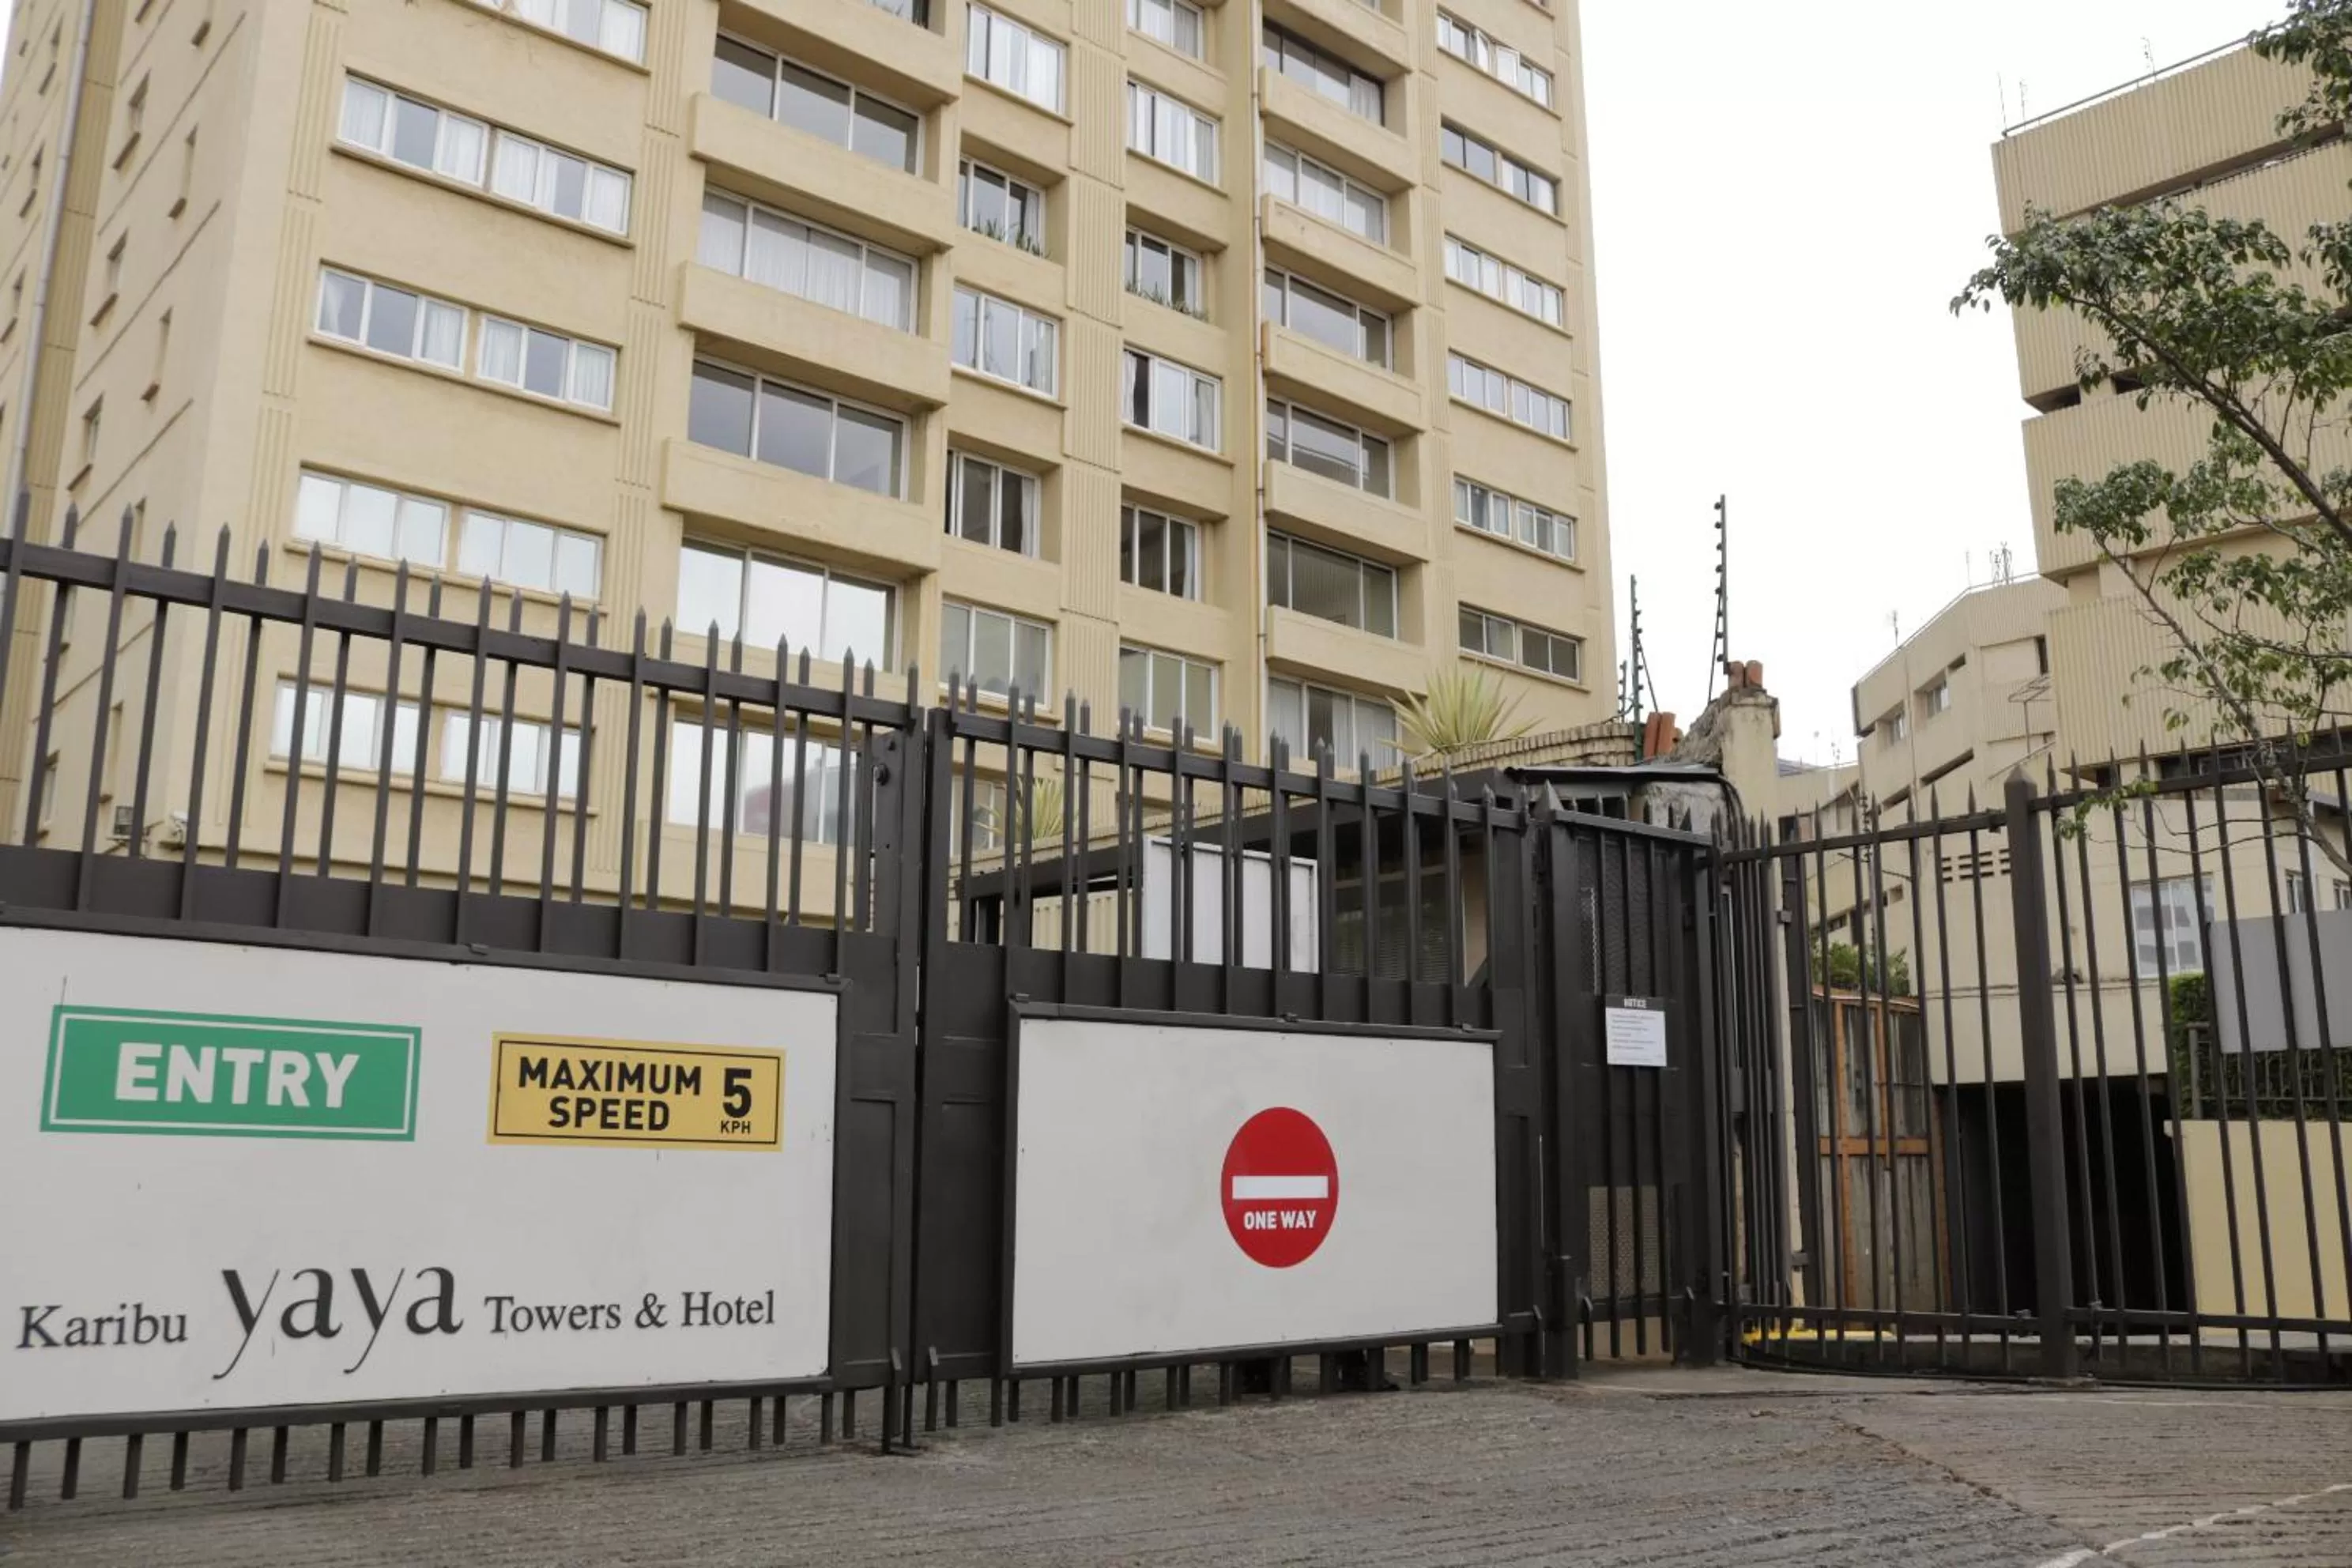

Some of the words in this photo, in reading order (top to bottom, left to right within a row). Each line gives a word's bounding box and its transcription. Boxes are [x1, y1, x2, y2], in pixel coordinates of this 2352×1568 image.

[115, 1042, 360, 1108] ENTRY
[518, 1056, 702, 1096] MAXIMUM
[722, 1067, 752, 1119] 5
[548, 1095, 670, 1132] SPEED
[720, 1120, 752, 1135] KPH
[1243, 1211, 1277, 1230] ONE
[1280, 1210, 1317, 1229] WAY
[16, 1302, 187, 1349] Karibu
[212, 1266, 465, 1381] yaya
[484, 1295, 622, 1334] Towers
[635, 1292, 668, 1329] &
[680, 1289, 775, 1328] Hotel
